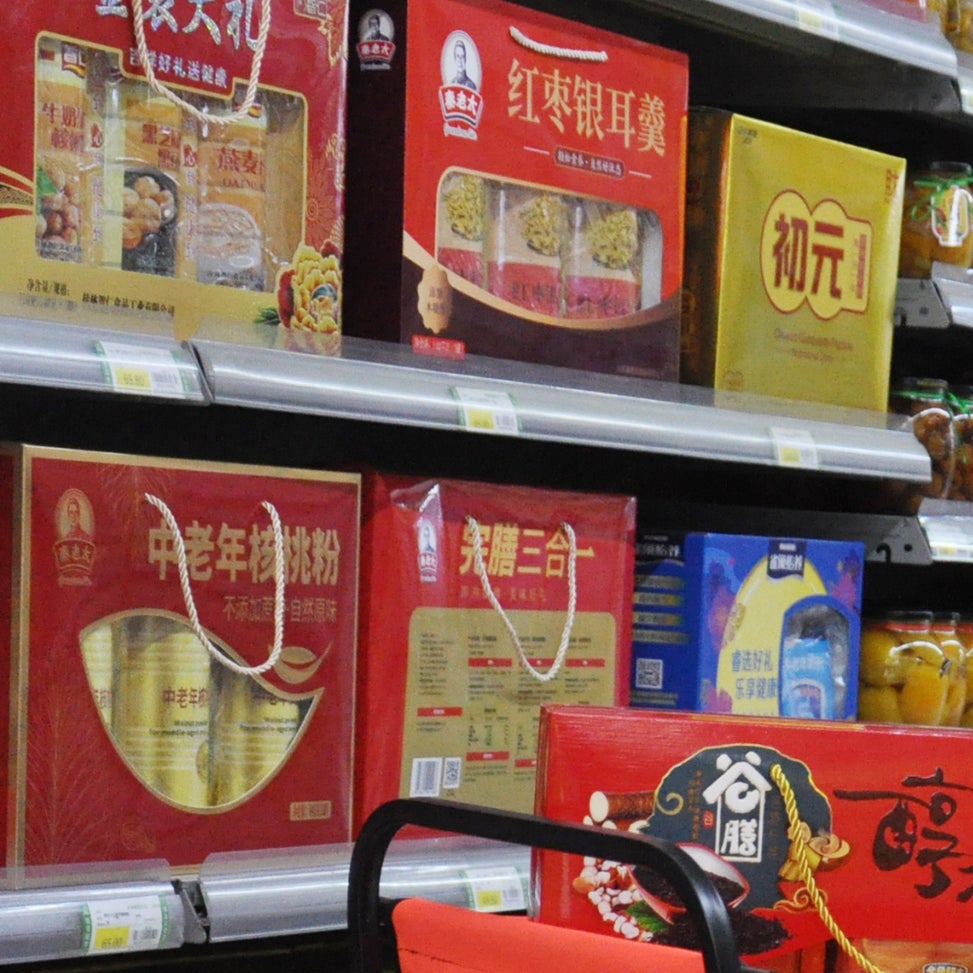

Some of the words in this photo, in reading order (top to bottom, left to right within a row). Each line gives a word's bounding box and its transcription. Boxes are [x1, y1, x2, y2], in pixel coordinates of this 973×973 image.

[508, 58, 666, 156] 红枣银耳羹
[773, 213, 844, 299] 初元
[148, 517, 341, 586] 中老年核桃粉
